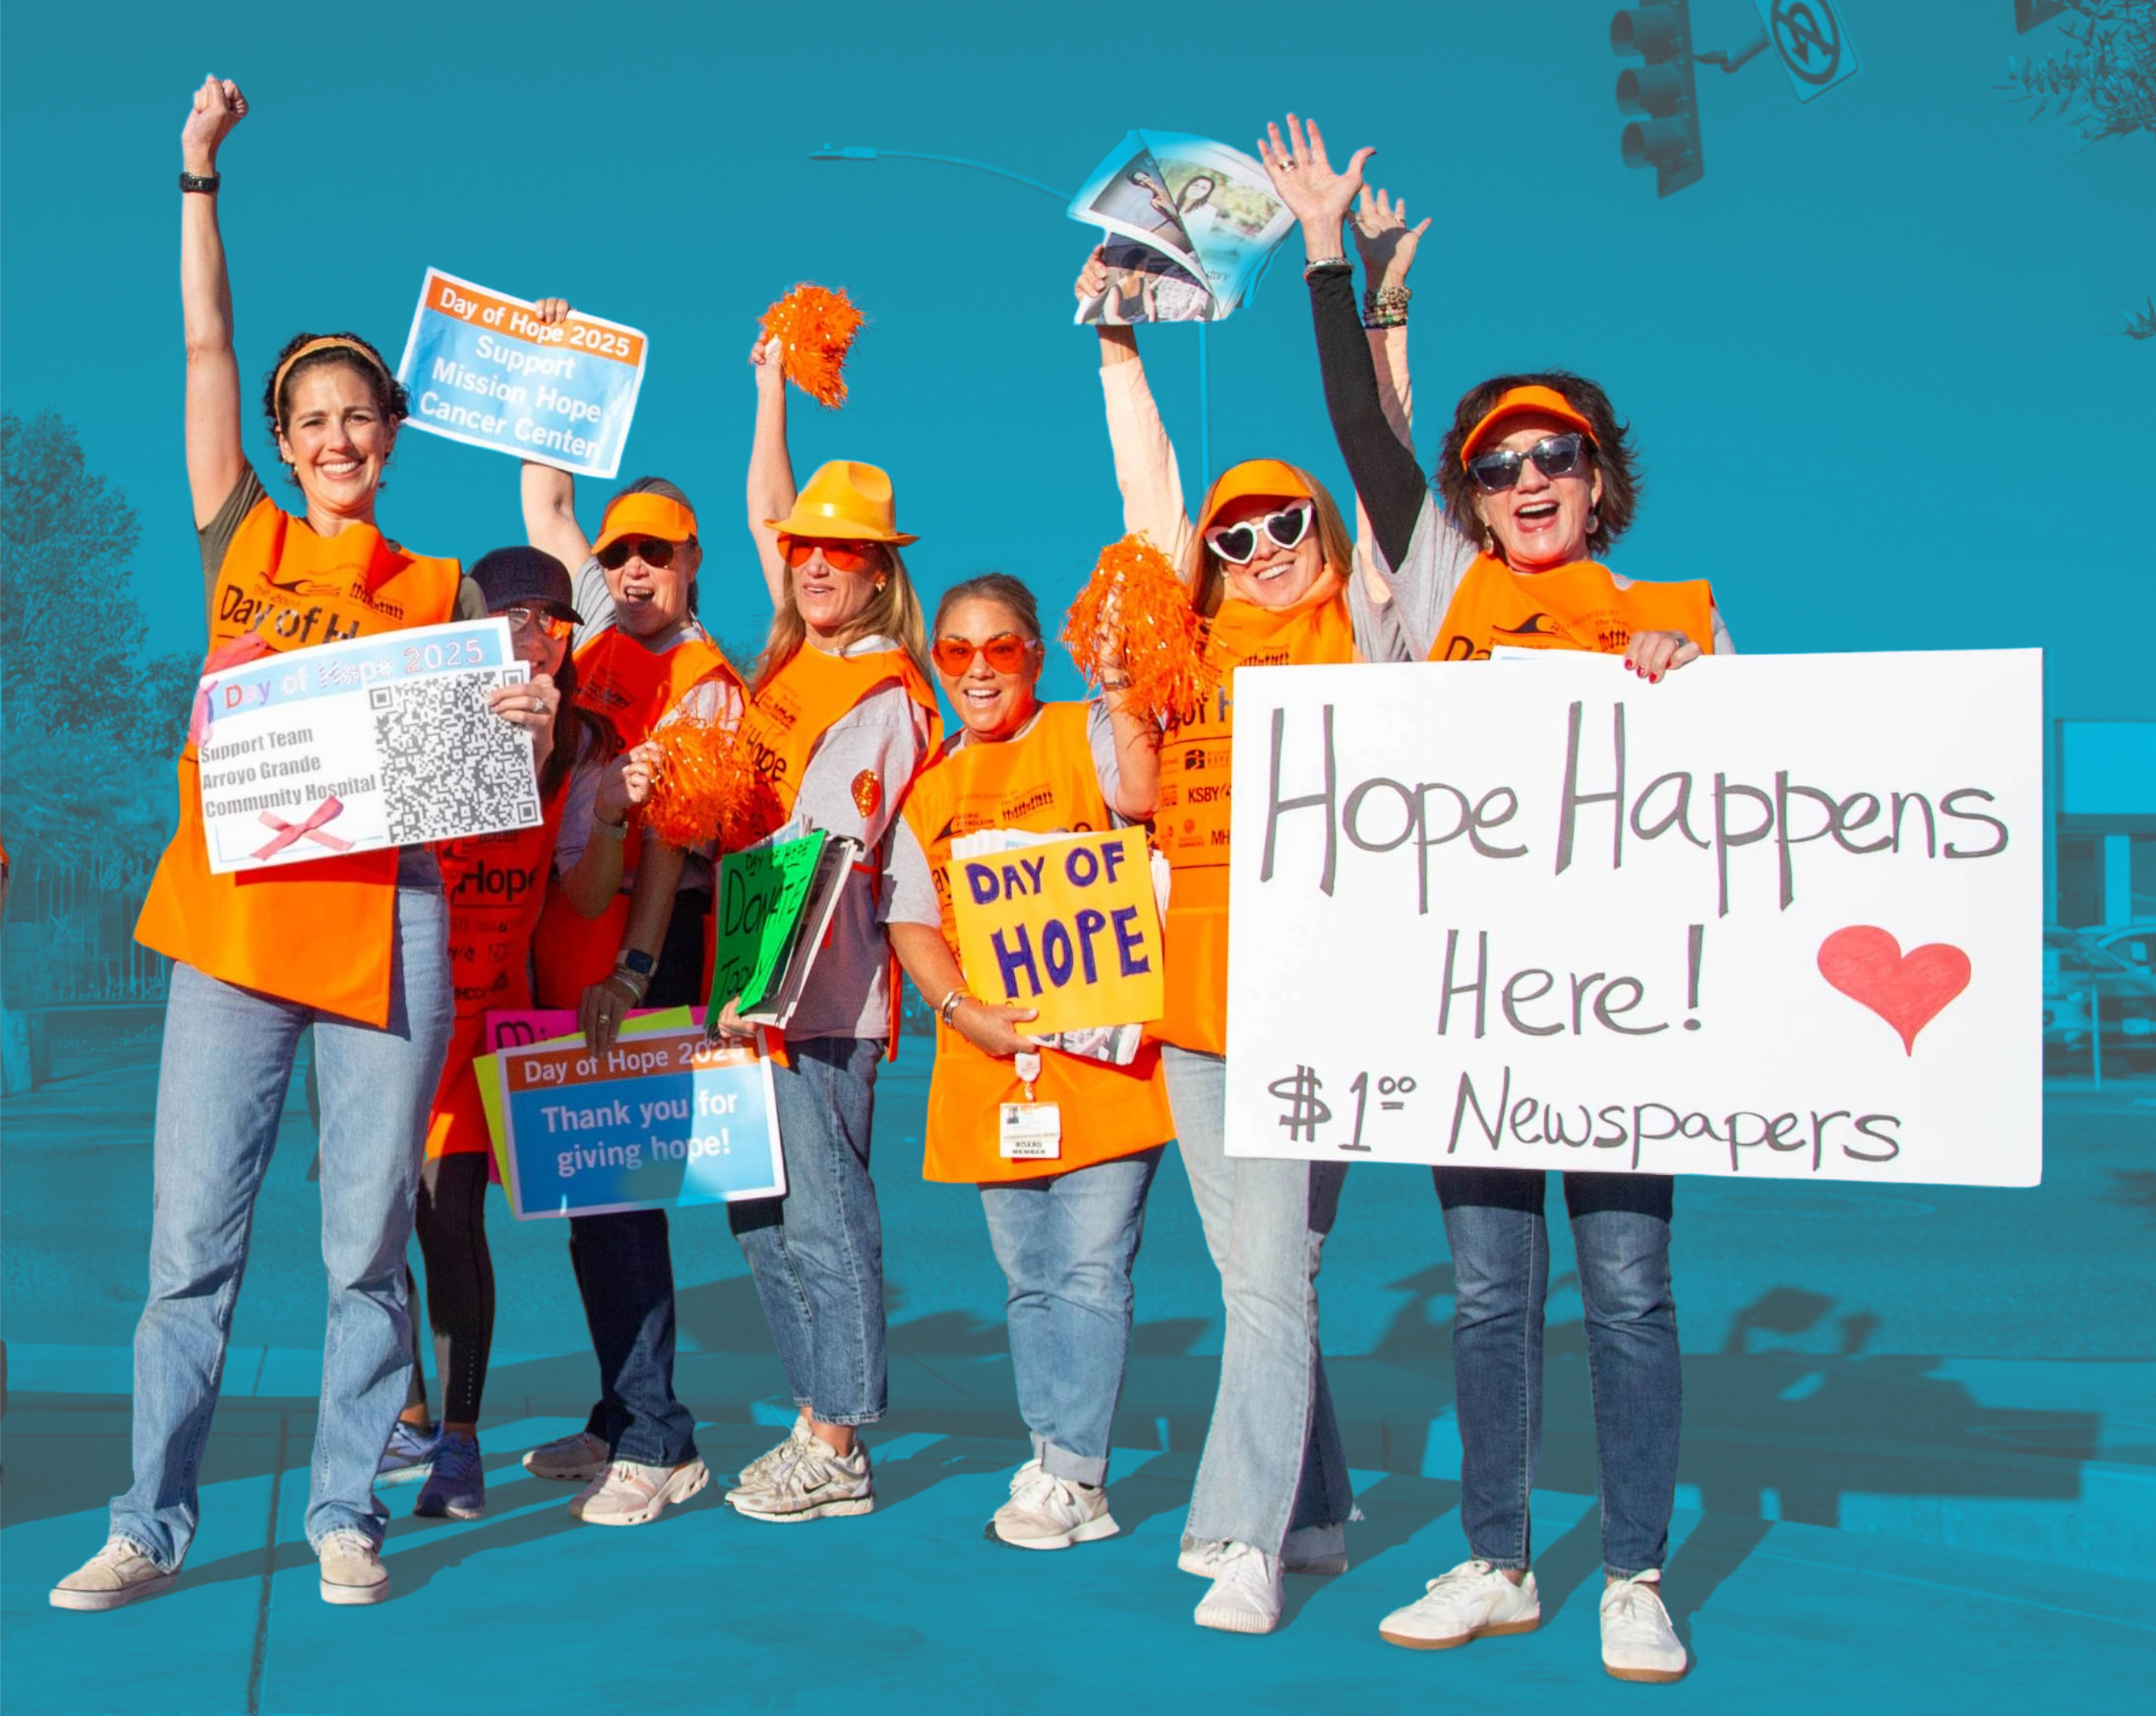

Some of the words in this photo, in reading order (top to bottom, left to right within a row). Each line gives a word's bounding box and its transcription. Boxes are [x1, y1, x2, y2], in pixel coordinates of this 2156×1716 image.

[440, 287, 478, 320] Day
[482, 306, 507, 325] of
[510, 312, 565, 344] Hope
[569, 325, 630, 357] 2025
[475, 335, 576, 379] Support
[432, 357, 527, 403] Mission
[536, 385, 602, 423] Hope
[420, 391, 506, 435] Cancer
[514, 418, 600, 459] Center
[220, 584, 274, 633] Day
[275, 606, 322, 643] of
[225, 680, 270, 710] Day
[281, 671, 311, 695] of
[318, 657, 395, 689] Hope
[403, 639, 483, 675] 2025
[200, 734, 265, 764] Support
[268, 727, 314, 750] Team
[203, 767, 256, 791] Arroyo
[260, 755, 321, 780] Grande
[205, 786, 302, 818] Community
[305, 773, 376, 803] Hospital
[1188, 786, 1220, 803] KSBY
[1261, 705, 1528, 914] Hope
[1555, 701, 2008, 918] Happens
[964, 856, 1045, 905] DAY
[1064, 840, 1125, 887] OF
[990, 904, 1151, 999] HOPE
[1438, 924, 1703, 1039] Here!
[524, 1060, 567, 1084] Day
[576, 1056, 599, 1076] of
[608, 1048, 669, 1074] Hope
[678, 1037, 745, 1064] 2025
[541, 1099, 631, 1134] Thank
[639, 1099, 689, 1129] you
[699, 1088, 738, 1116] for
[1447, 1066, 1901, 1171] Newspapers
[558, 1141, 643, 1178] giving
[651, 1129, 731, 1165] hope!
